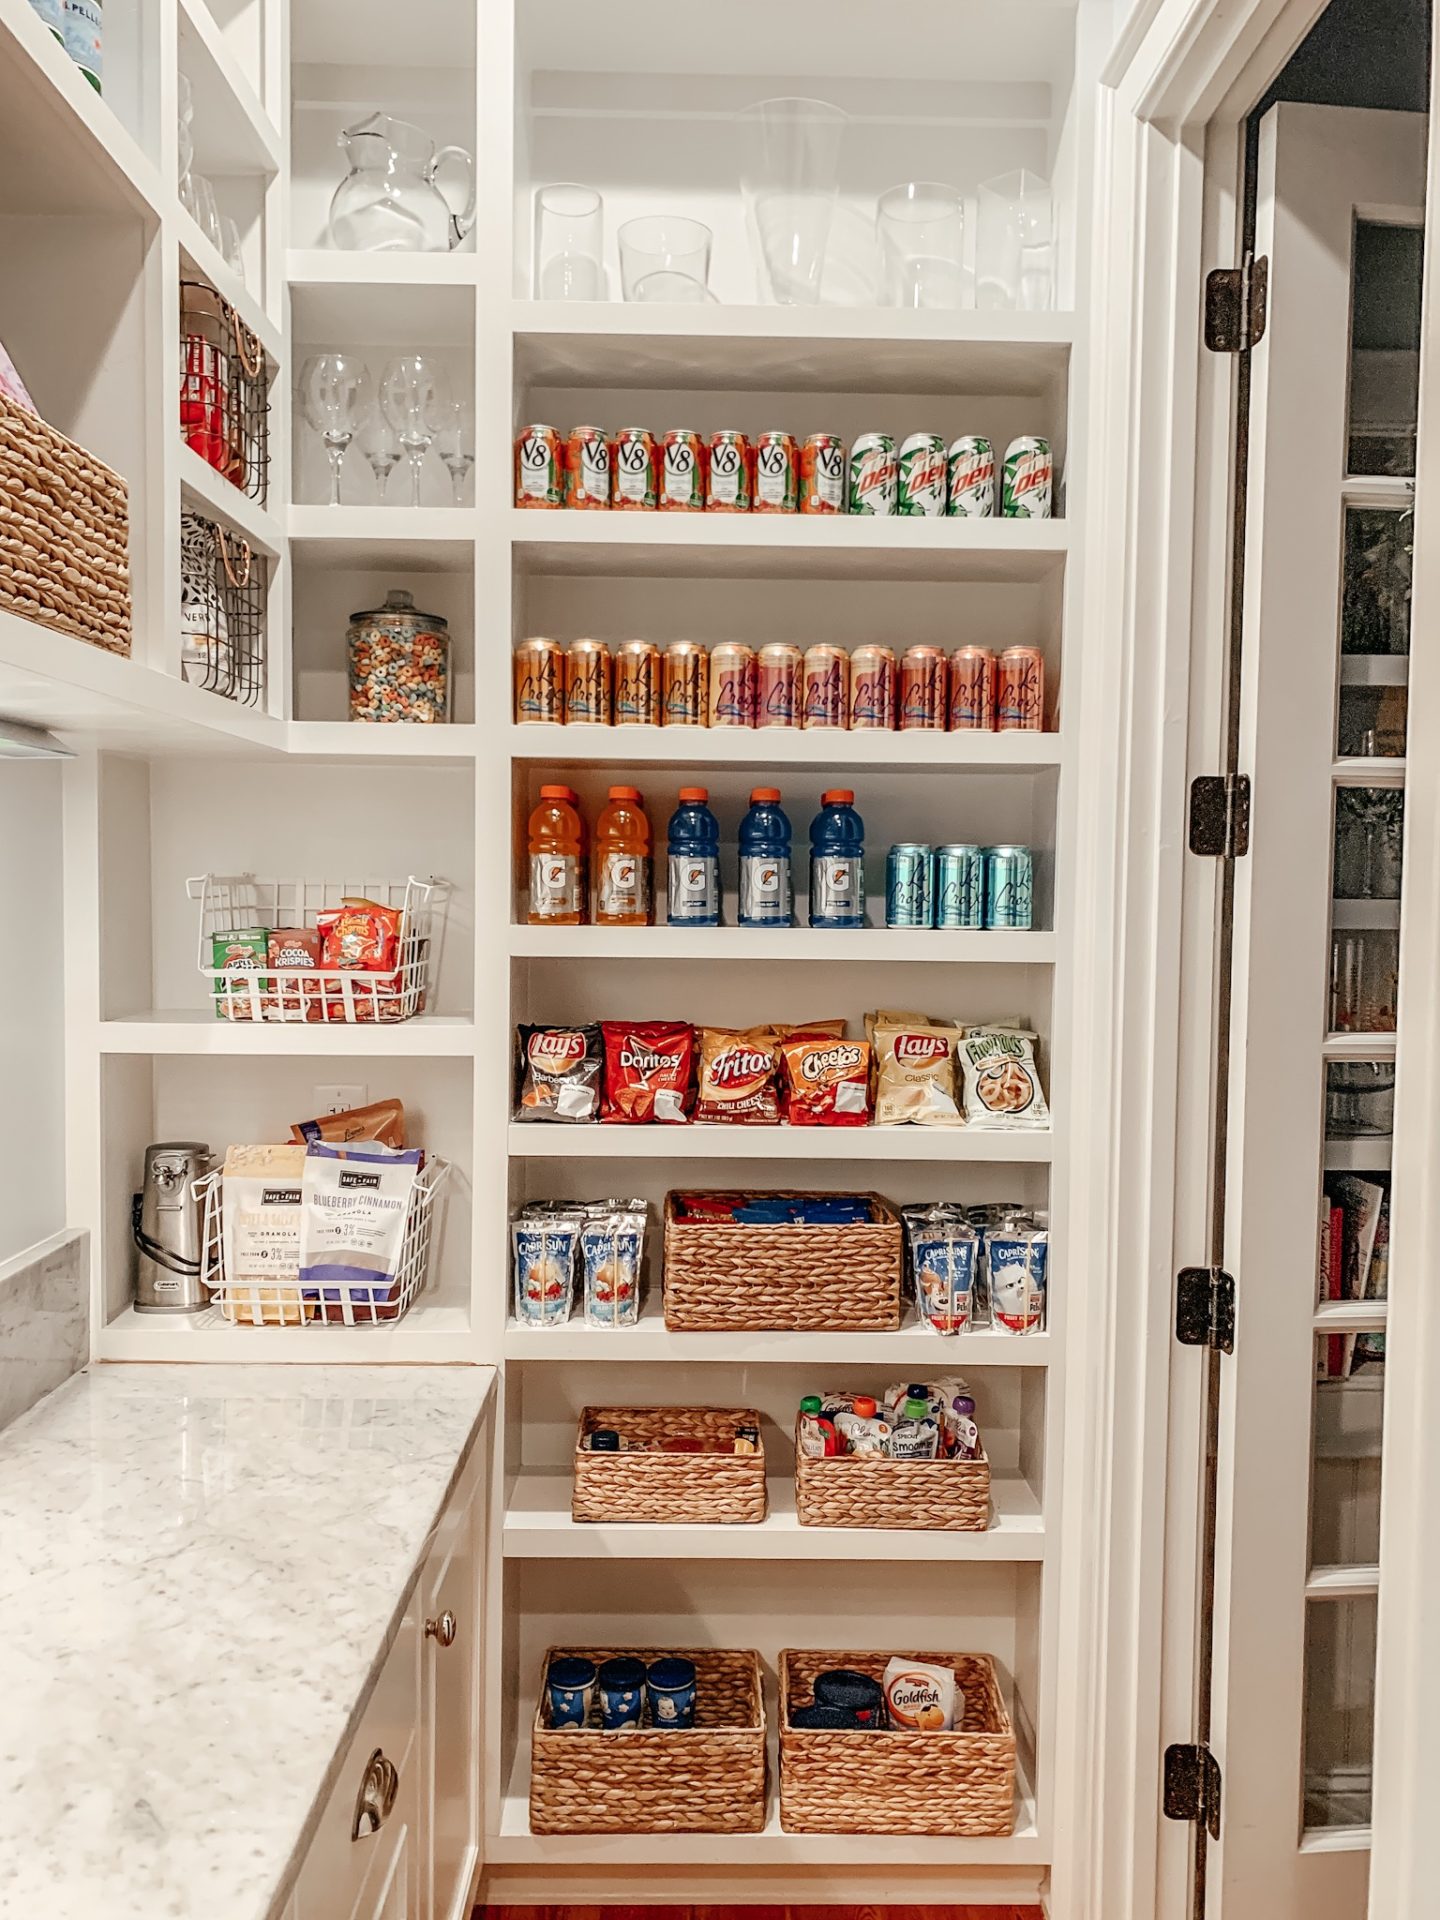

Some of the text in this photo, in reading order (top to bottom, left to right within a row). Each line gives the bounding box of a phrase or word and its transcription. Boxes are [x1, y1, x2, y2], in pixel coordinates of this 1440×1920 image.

[524, 438, 546, 467] V8
[584, 440, 607, 470] V8
[619, 441, 645, 470] V8
[667, 442, 691, 472] V8
[712, 444, 737, 473] V8
[760, 444, 784, 474] V8
[820, 447, 842, 477] V8
[1017, 662, 1038, 691] La
[1000, 685, 1041, 714] Croix
[541, 860, 566, 888] G
[611, 860, 636, 888] G
[680, 862, 706, 891] G
[754, 862, 779, 891] G
[826, 862, 849, 891] G
[275, 957, 315, 968] KRISPIES
[280, 948, 309, 958] COCOA
[532, 1034, 582, 1059] Lay's
[620, 1052, 680, 1069] Doritos
[711, 1050, 772, 1086] Fritos
[803, 1045, 861, 1081] Cheetos
[904, 1073, 939, 1083] Classic
[343, 1176, 357, 1184] SAFE
[313, 1194, 403, 1210] BLUEBERRY CINNAMON
[343, 1223, 356, 1236] 3%
[270, 1247, 282, 1261] 3%
[518, 1238, 567, 1255] CAPR SUN
[998, 1246, 1040, 1260] CAPRI SN
[893, 1689, 939, 1706] Goldfish
